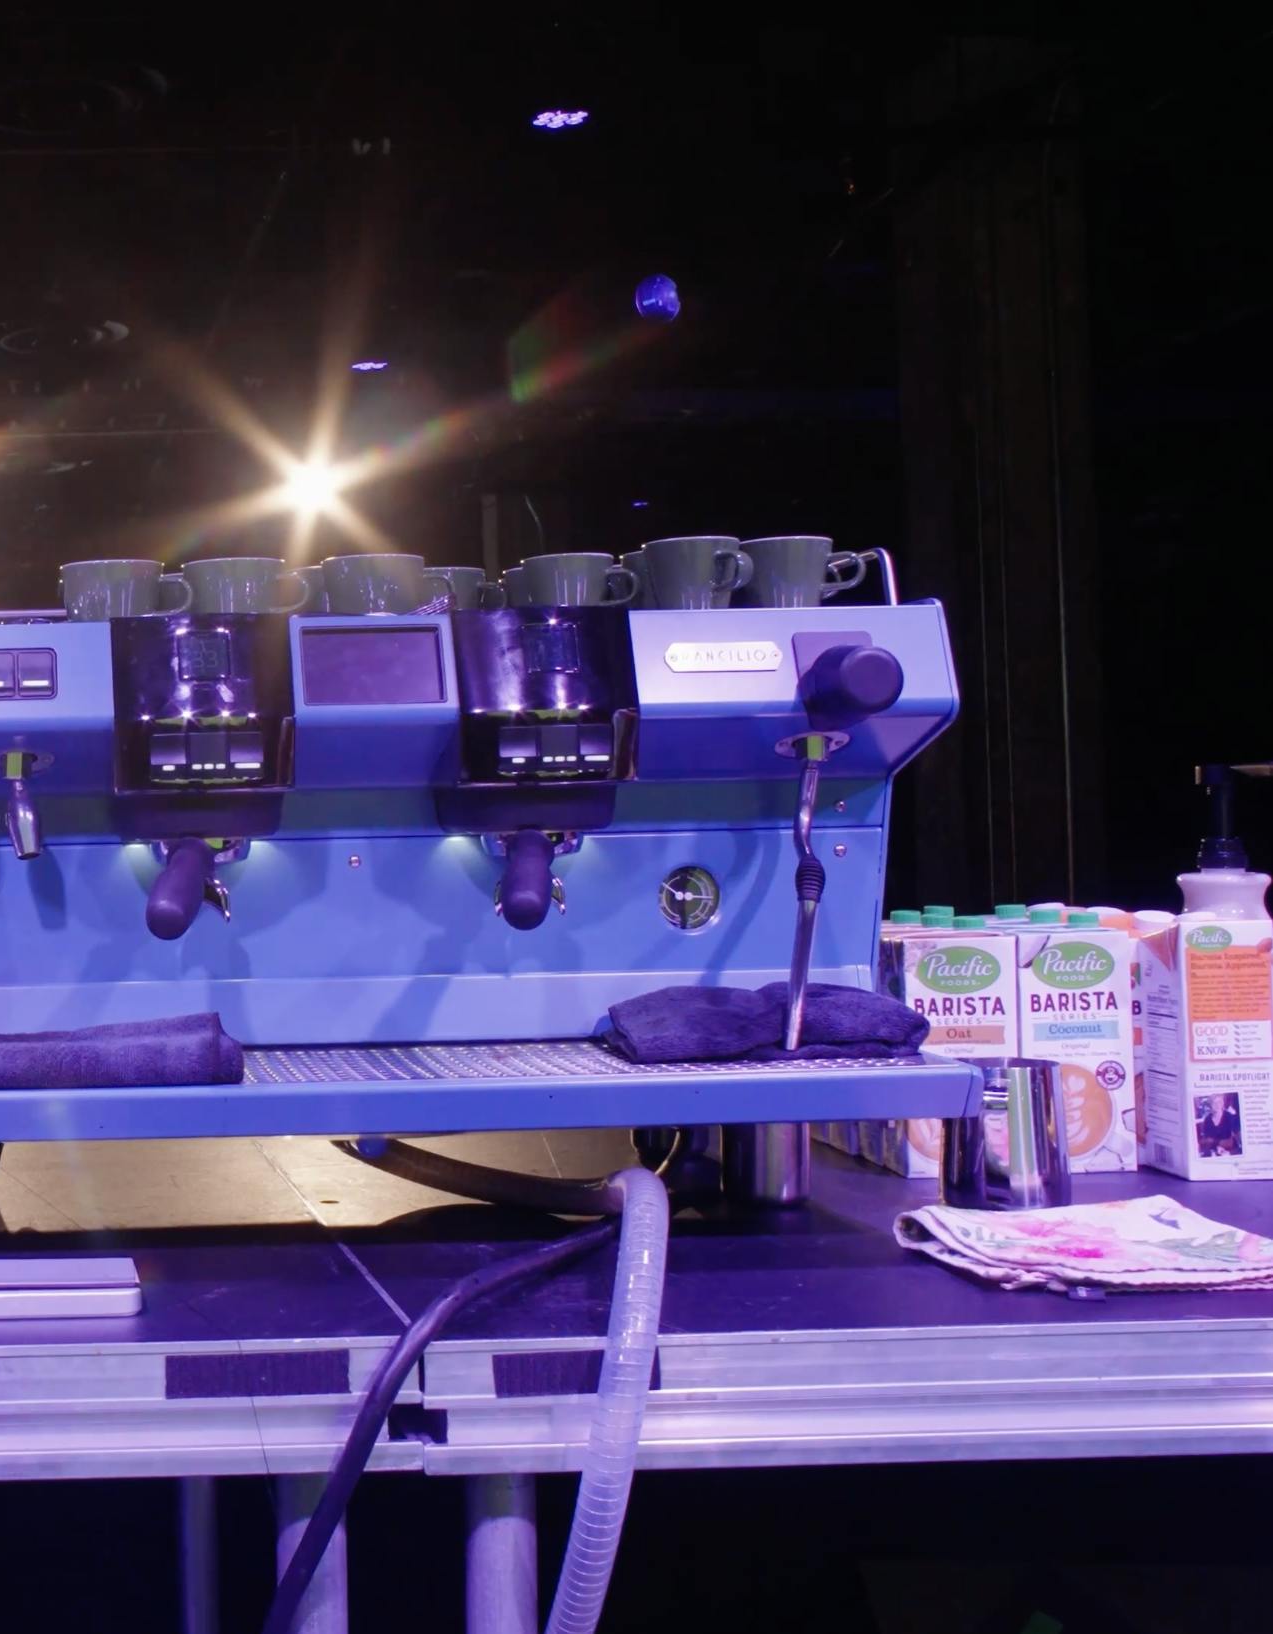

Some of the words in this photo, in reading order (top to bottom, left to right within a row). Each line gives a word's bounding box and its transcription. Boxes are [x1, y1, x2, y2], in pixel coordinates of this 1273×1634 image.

[923, 953, 993, 979] Pacific
[1039, 949, 1107, 974] Pacific
[914, 996, 1005, 1016] BARISTA
[1030, 992, 1118, 1012] BARISTA
[946, 1028, 973, 1039] Oat
[1048, 1023, 1102, 1035] Coconut
[1197, 1045, 1228, 1055] KNOW
